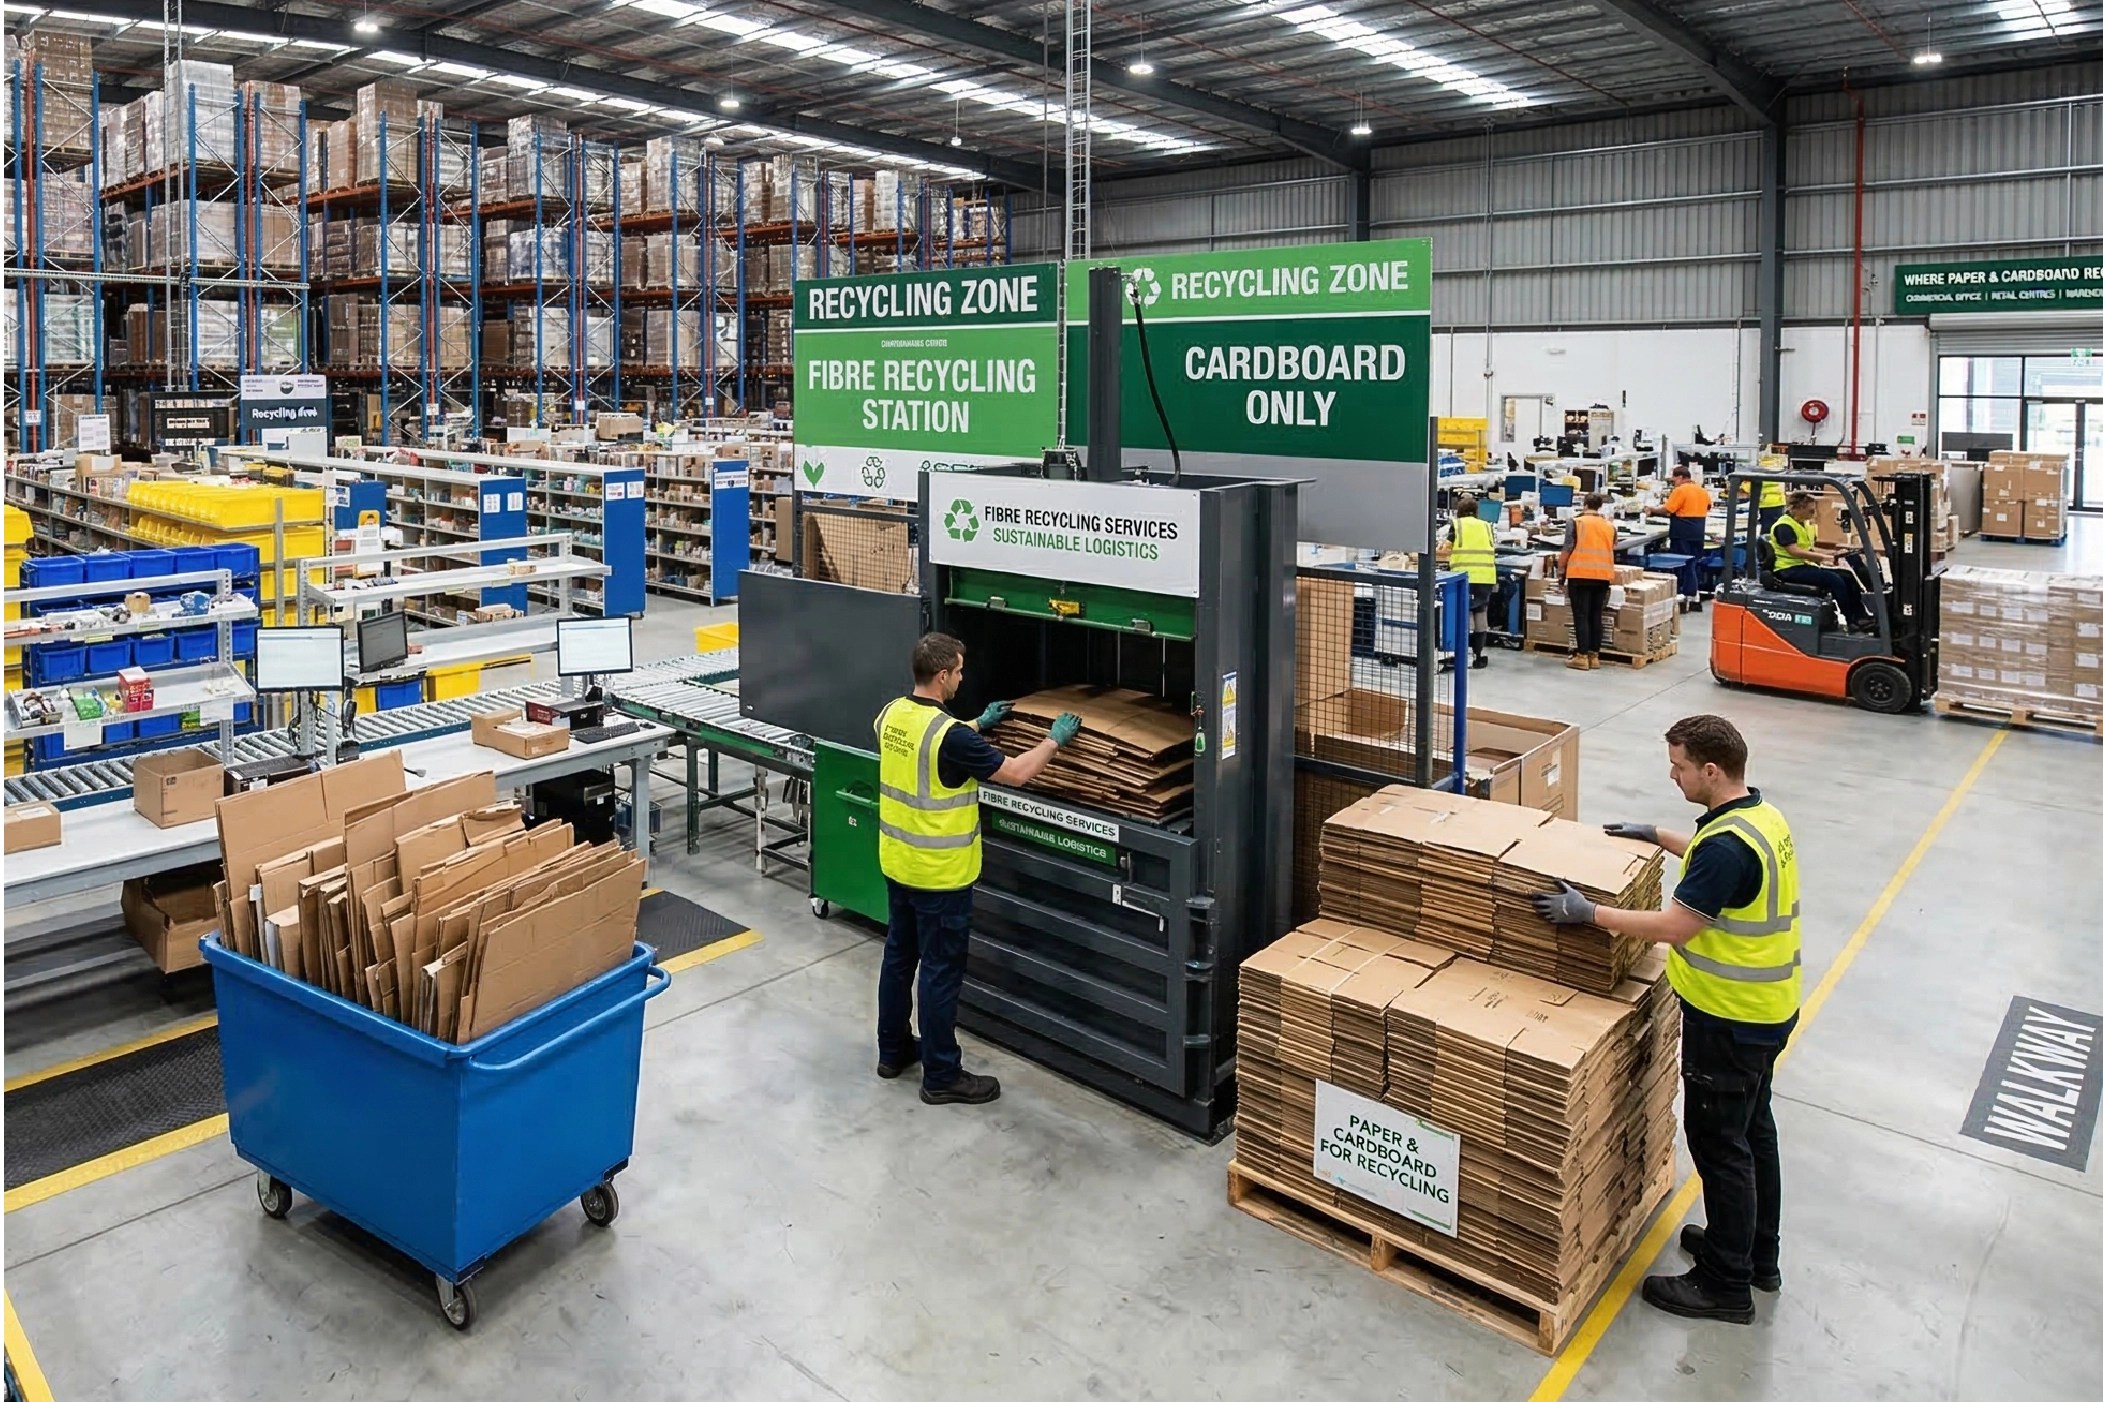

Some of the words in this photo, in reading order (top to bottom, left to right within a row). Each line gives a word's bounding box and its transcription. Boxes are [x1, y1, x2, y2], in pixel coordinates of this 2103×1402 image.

[1171, 266, 1319, 299] RECYCLING
[1329, 260, 1409, 294] ZONE
[1904, 273, 1945, 286] WHERE
[1948, 271, 1986, 284] PAPER
[2083, 266, 2103, 279] RE
[808, 281, 952, 320] RECYCLING
[960, 275, 1038, 315] ZONE
[808, 359, 876, 391] FIBRE
[884, 358, 1036, 393] RECYCLING
[1185, 344, 1406, 380] CARDBOARD
[862, 398, 969, 434] STATION
[1246, 389, 1337, 426] ONLY
[984, 505, 1021, 525] FIBRE
[1025, 508, 1101, 533] RECYCLING
[1104, 516, 1179, 540] SERVICES
[993, 527, 1081, 552] SUSTAINABLE
[1085, 536, 1159, 561] LOGISTICS
[983, 790, 1009, 807] FIBRE
[1011, 800, 1064, 823] RECYCLING
[1065, 814, 1116, 837] SERVICES
[1983, 1004, 2097, 1151] WALKWAY
[1333, 1127, 1437, 1179] CARDBOARD
[1350, 1114, 1402, 1148] PAPER
[1406, 1137, 1420, 1155] &
[1320, 1138, 1352, 1164] FOR
[1357, 1152, 1450, 1204] RECYCLING
